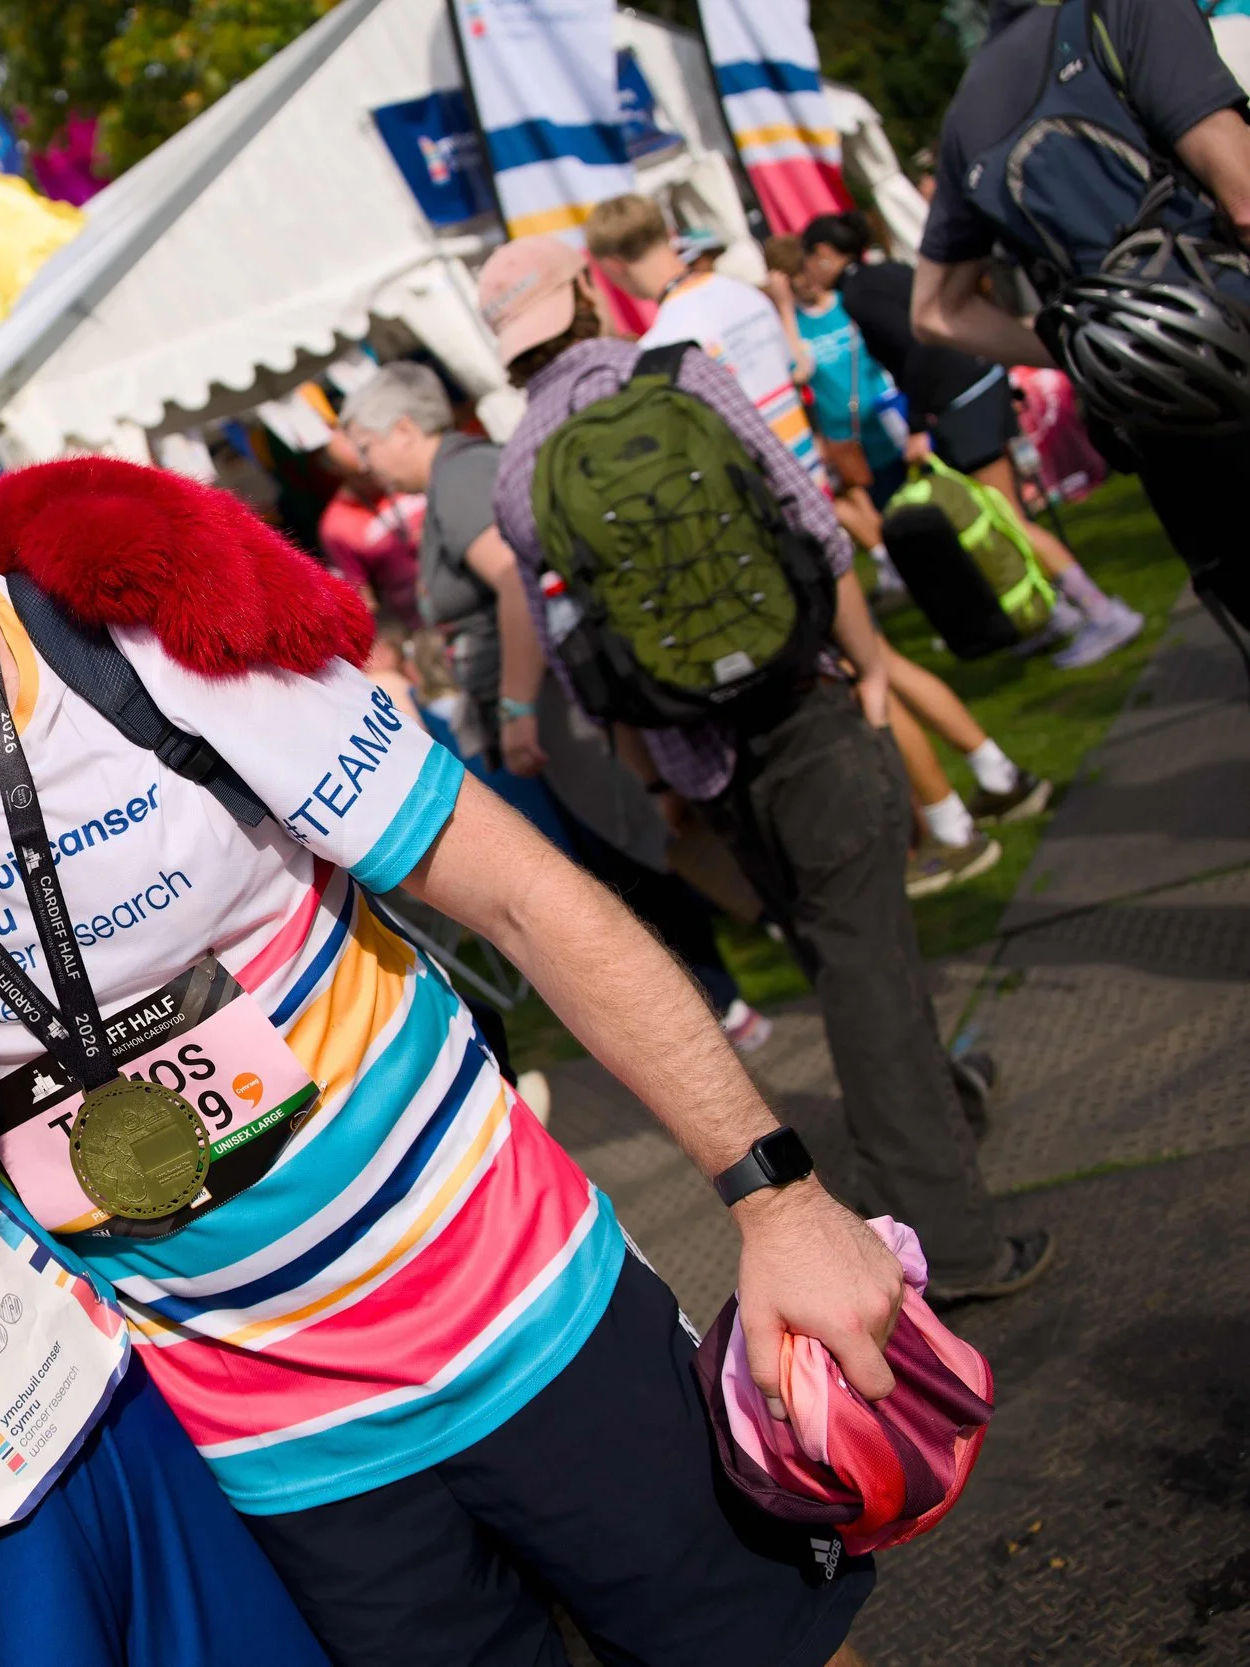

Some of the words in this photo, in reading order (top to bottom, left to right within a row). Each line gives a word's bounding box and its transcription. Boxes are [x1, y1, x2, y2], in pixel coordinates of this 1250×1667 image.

[1, 711, 18, 754] 2026
[40, 875, 68, 939] CARDIFF
[58, 940, 81, 981] HALF
[73, 869, 193, 948] search
[31, 879, 44, 909] HANNER
[38, 909, 54, 949] MARATHON
[50, 948, 66, 985] CAERDYDD
[0, 959, 29, 992] MARATHON
[28, 991, 48, 1014] HANNER
[127, 994, 175, 1032] HALF
[74, 1013, 100, 1058] 2026
[111, 1035, 145, 1058] RATHON
[143, 1012, 186, 1040] CAERDYDD
[235, 1078, 261, 1095] Cymraeg
[213, 1129, 252, 1155] UNISEX
[251, 1108, 285, 1134] LARGE
[0, 1375, 41, 1428] ymchwil
[37, 1340, 62, 1379] canser
[19, 1406, 51, 1448] cancer
[48, 1364, 80, 1412] research
[10, 1399, 41, 1437] cymru
[29, 1423, 58, 1458] wales
[822, 1538, 842, 1582] didas
